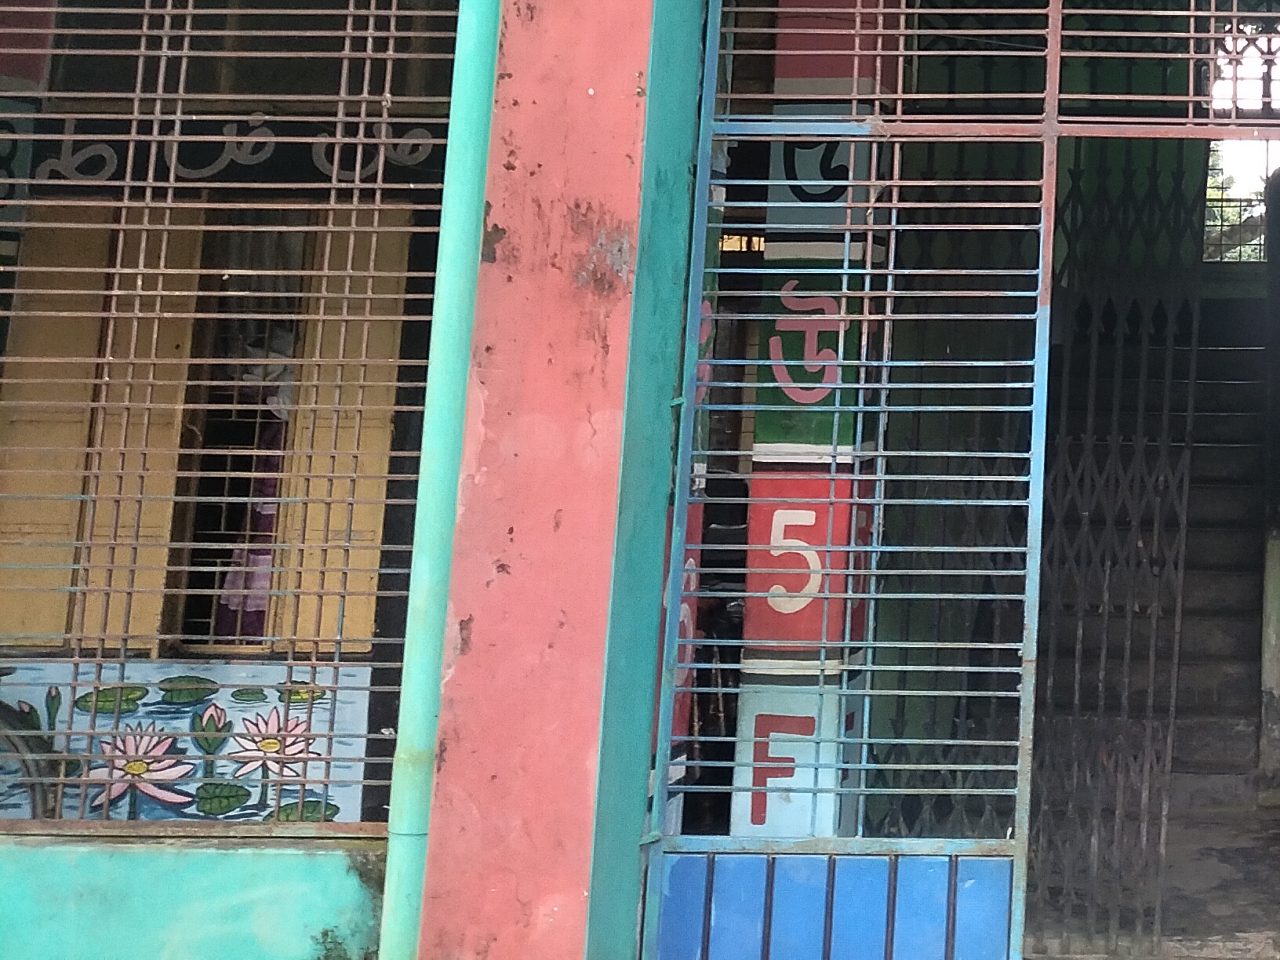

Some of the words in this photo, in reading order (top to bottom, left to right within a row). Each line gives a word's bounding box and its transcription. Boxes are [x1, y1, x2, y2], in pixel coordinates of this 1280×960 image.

[768, 279, 850, 404] উ
[766, 509, 822, 614] 5
[751, 713, 816, 826] F
